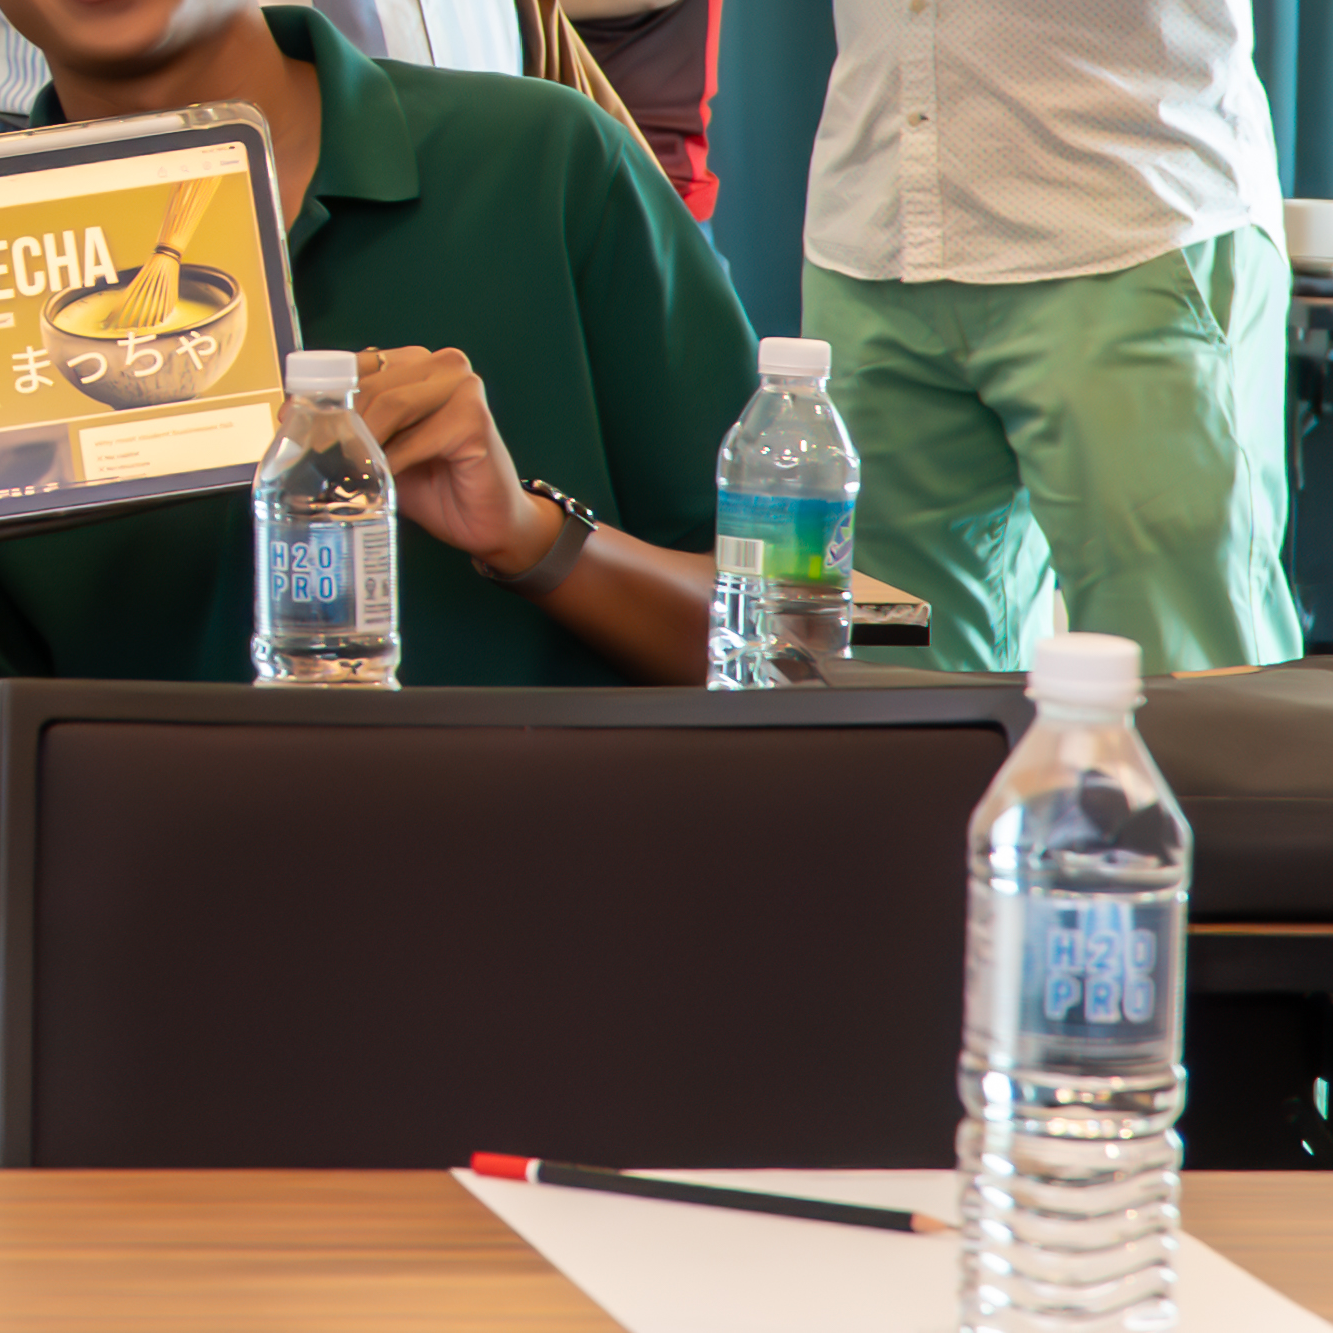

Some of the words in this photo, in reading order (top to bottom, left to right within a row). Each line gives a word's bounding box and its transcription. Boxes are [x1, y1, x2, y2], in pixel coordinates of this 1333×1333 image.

[11, 330, 218, 395] まっちゃ
[271, 572, 337, 602] PRO
[1044, 974, 1156, 1023] PRO
